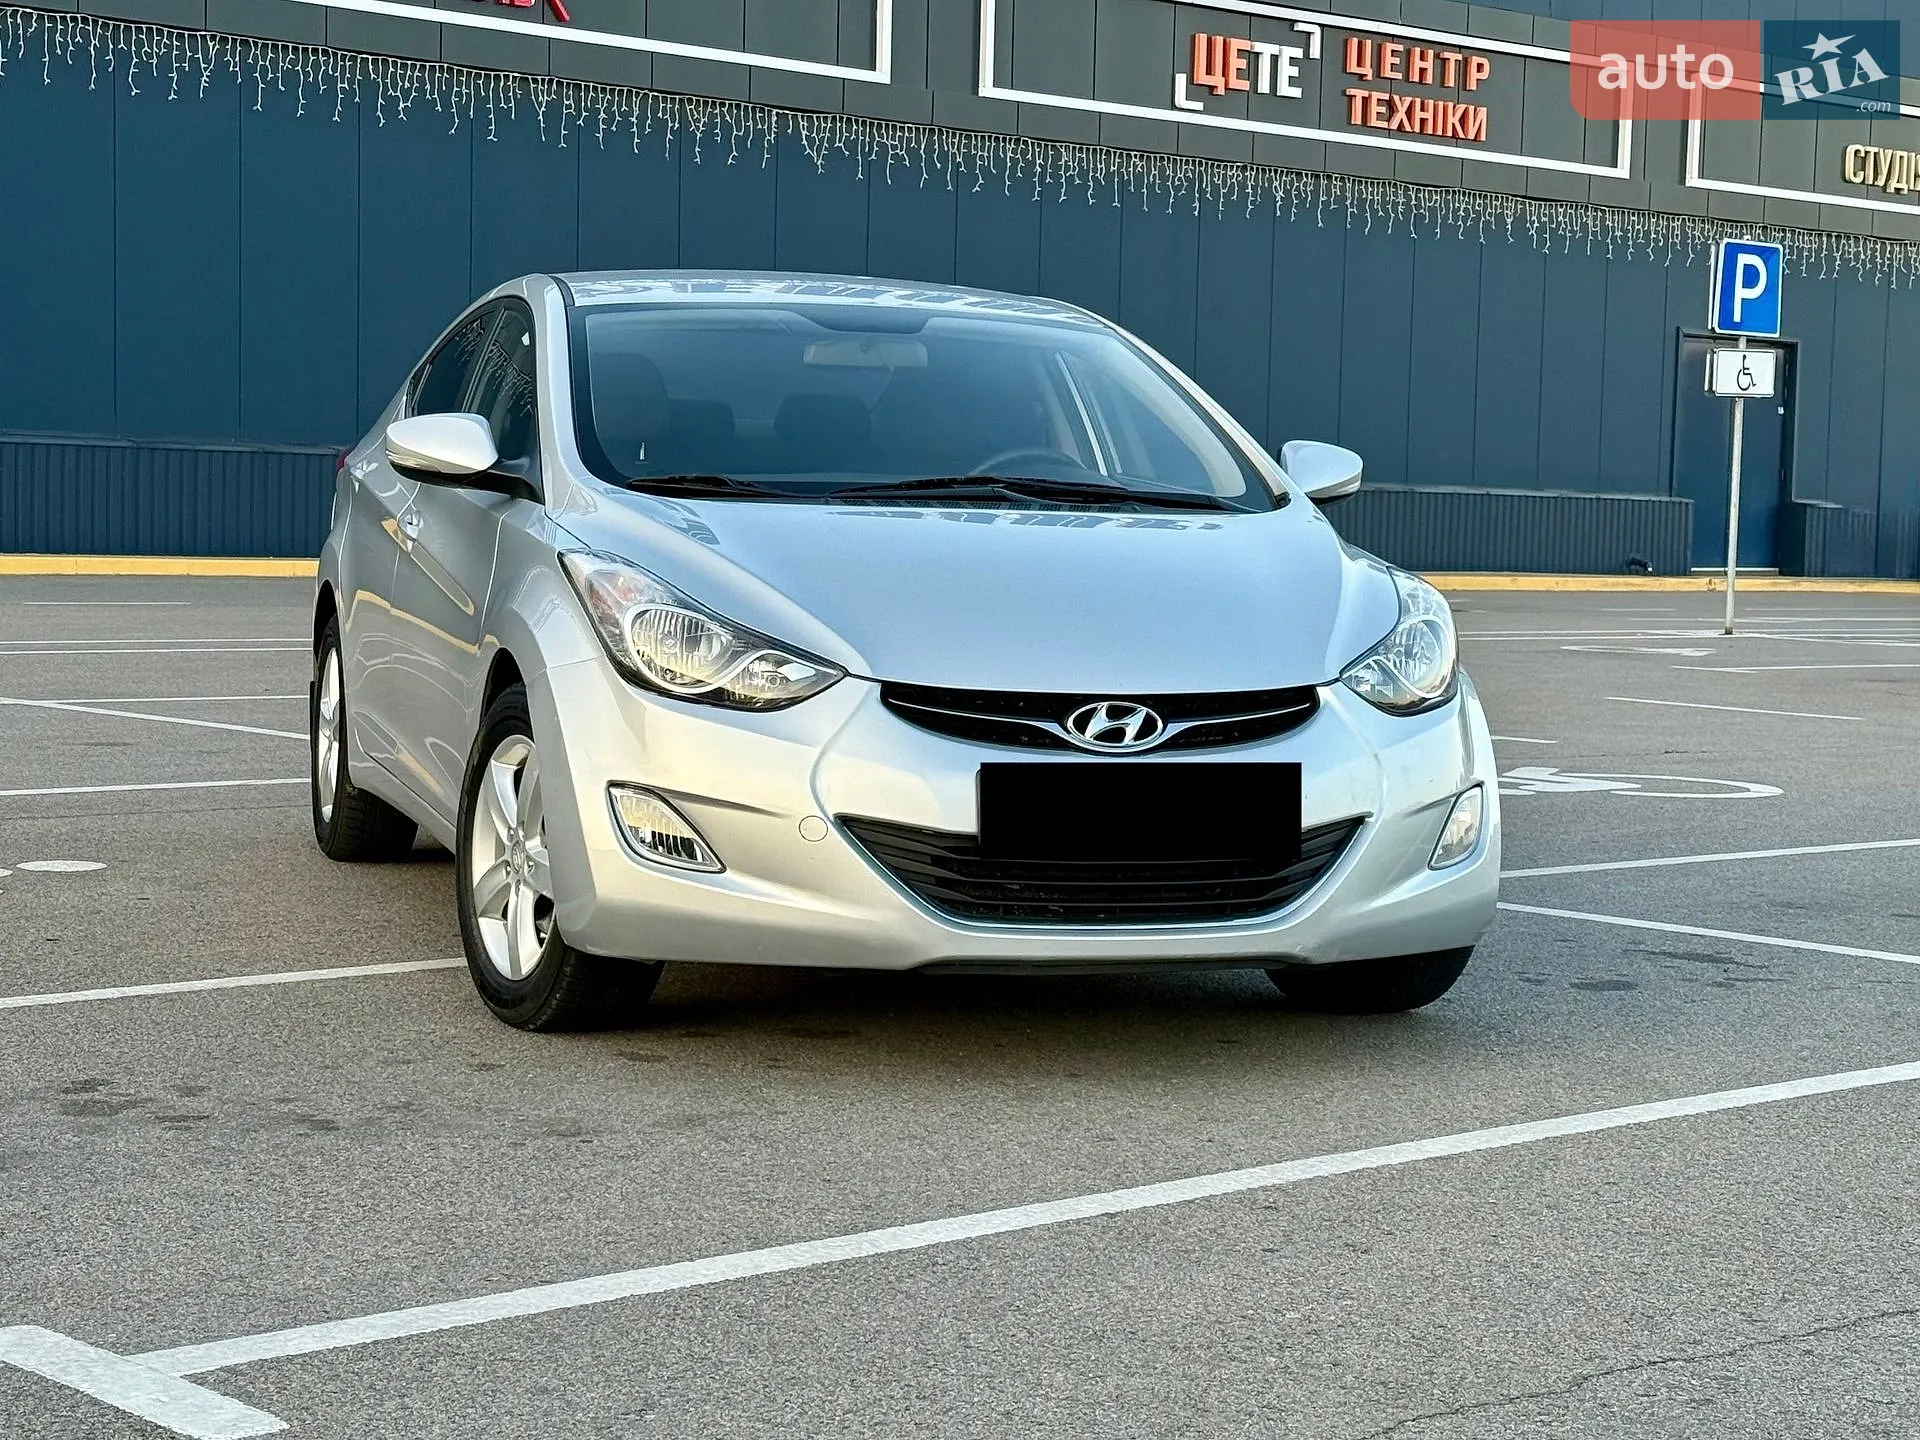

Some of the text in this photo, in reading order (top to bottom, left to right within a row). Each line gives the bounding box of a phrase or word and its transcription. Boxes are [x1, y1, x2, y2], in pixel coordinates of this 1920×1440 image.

[1192, 32, 1303, 98] ЦЕТЕ
[1346, 37, 1490, 91] ЦЕНТР
[1346, 88, 1488, 142] ТЕХНІКИ
[1733, 253, 1767, 323] P
